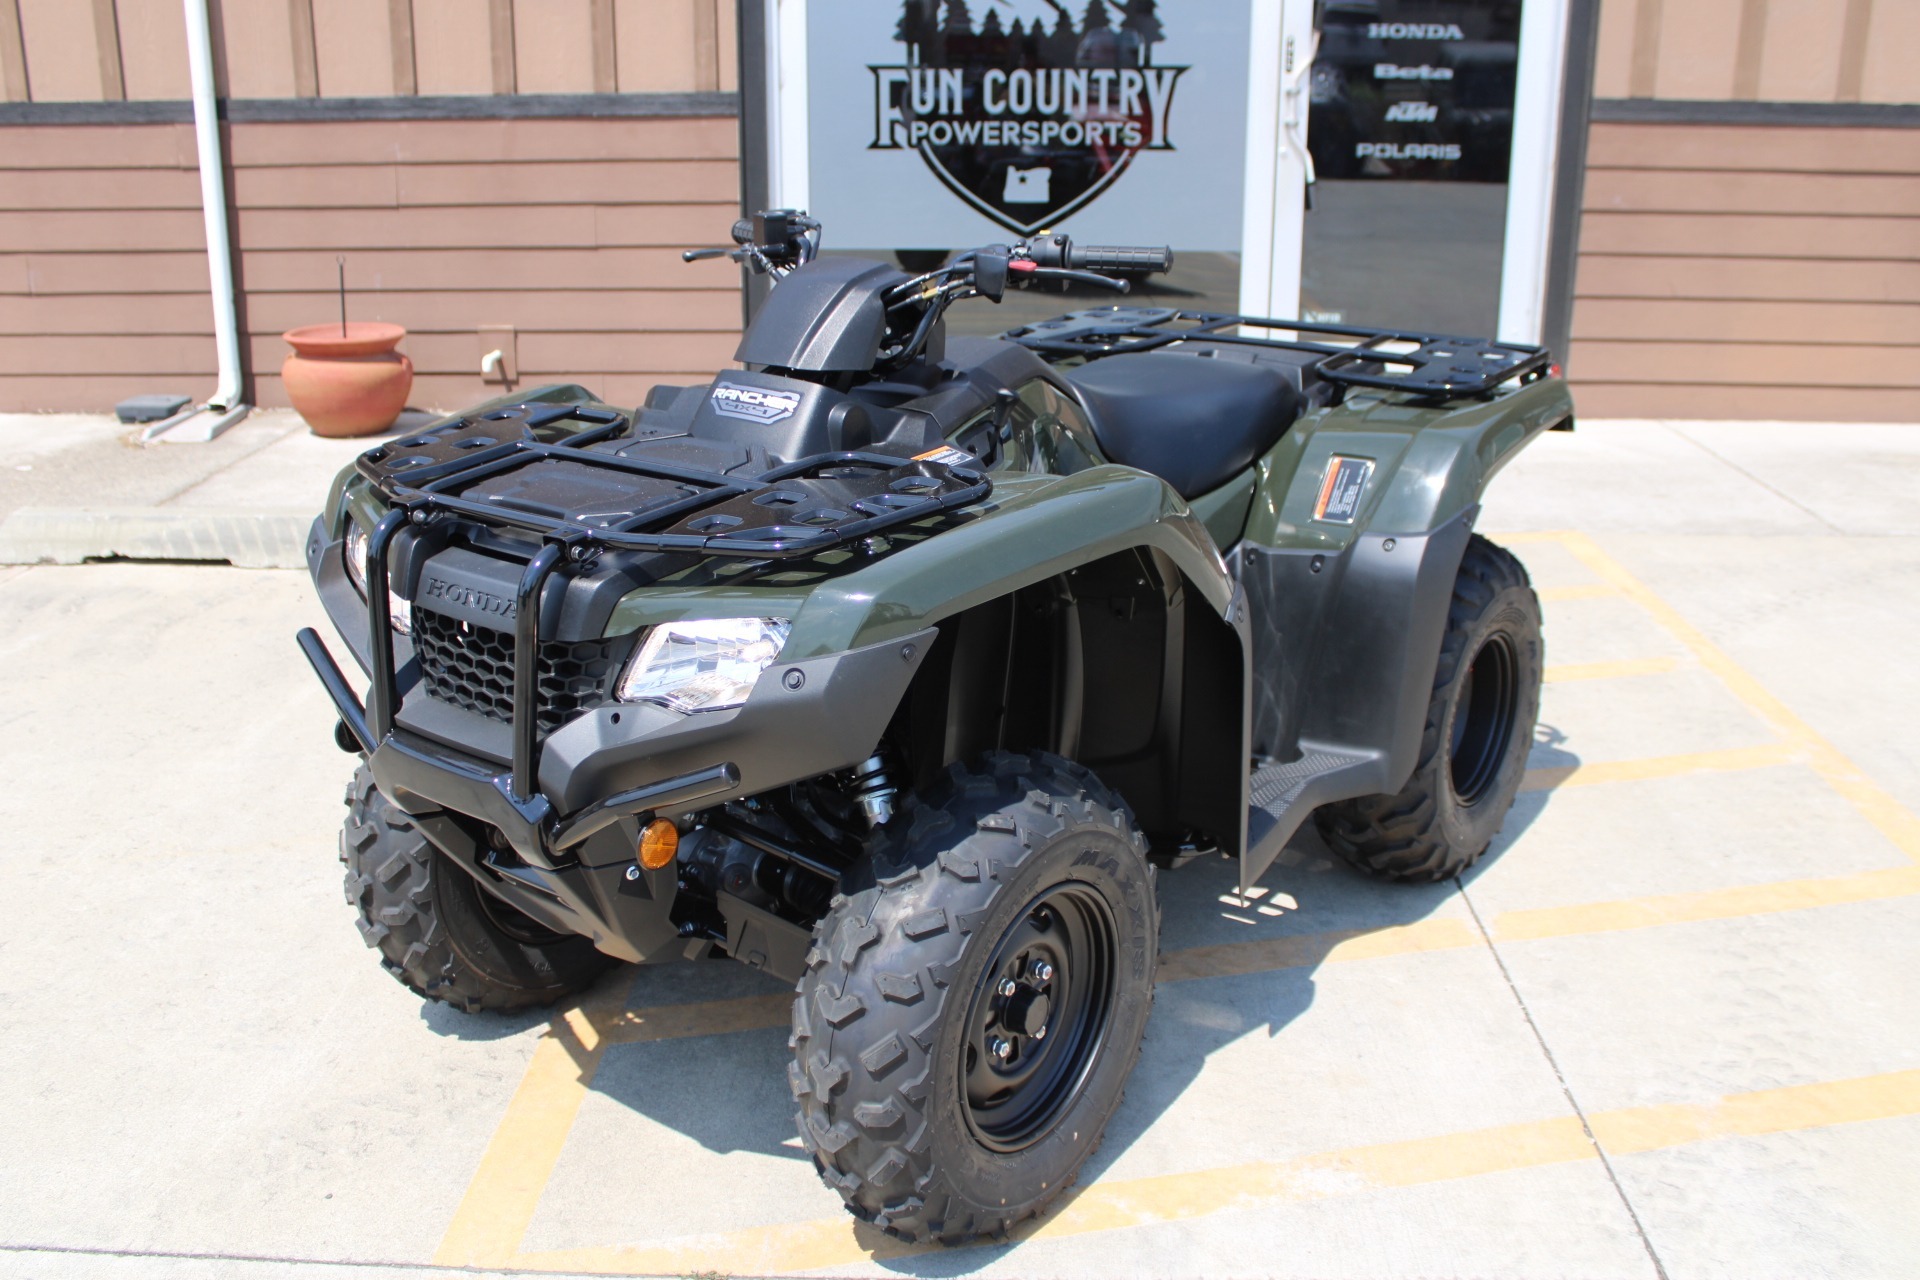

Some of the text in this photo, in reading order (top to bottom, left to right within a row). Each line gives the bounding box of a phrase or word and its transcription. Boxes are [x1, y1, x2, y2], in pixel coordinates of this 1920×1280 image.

[1367, 23, 1465, 40] HONDA
[1373, 63, 1454, 80] Beta
[874, 66, 1180, 149] FUN COUNTRY
[1385, 101, 1439, 122] KTM
[910, 120, 1143, 147] POWERSPORTS
[1355, 143, 1462, 160] POLARIS
[712, 387, 799, 413] RANCHER
[426, 577, 517, 619] HONDA
